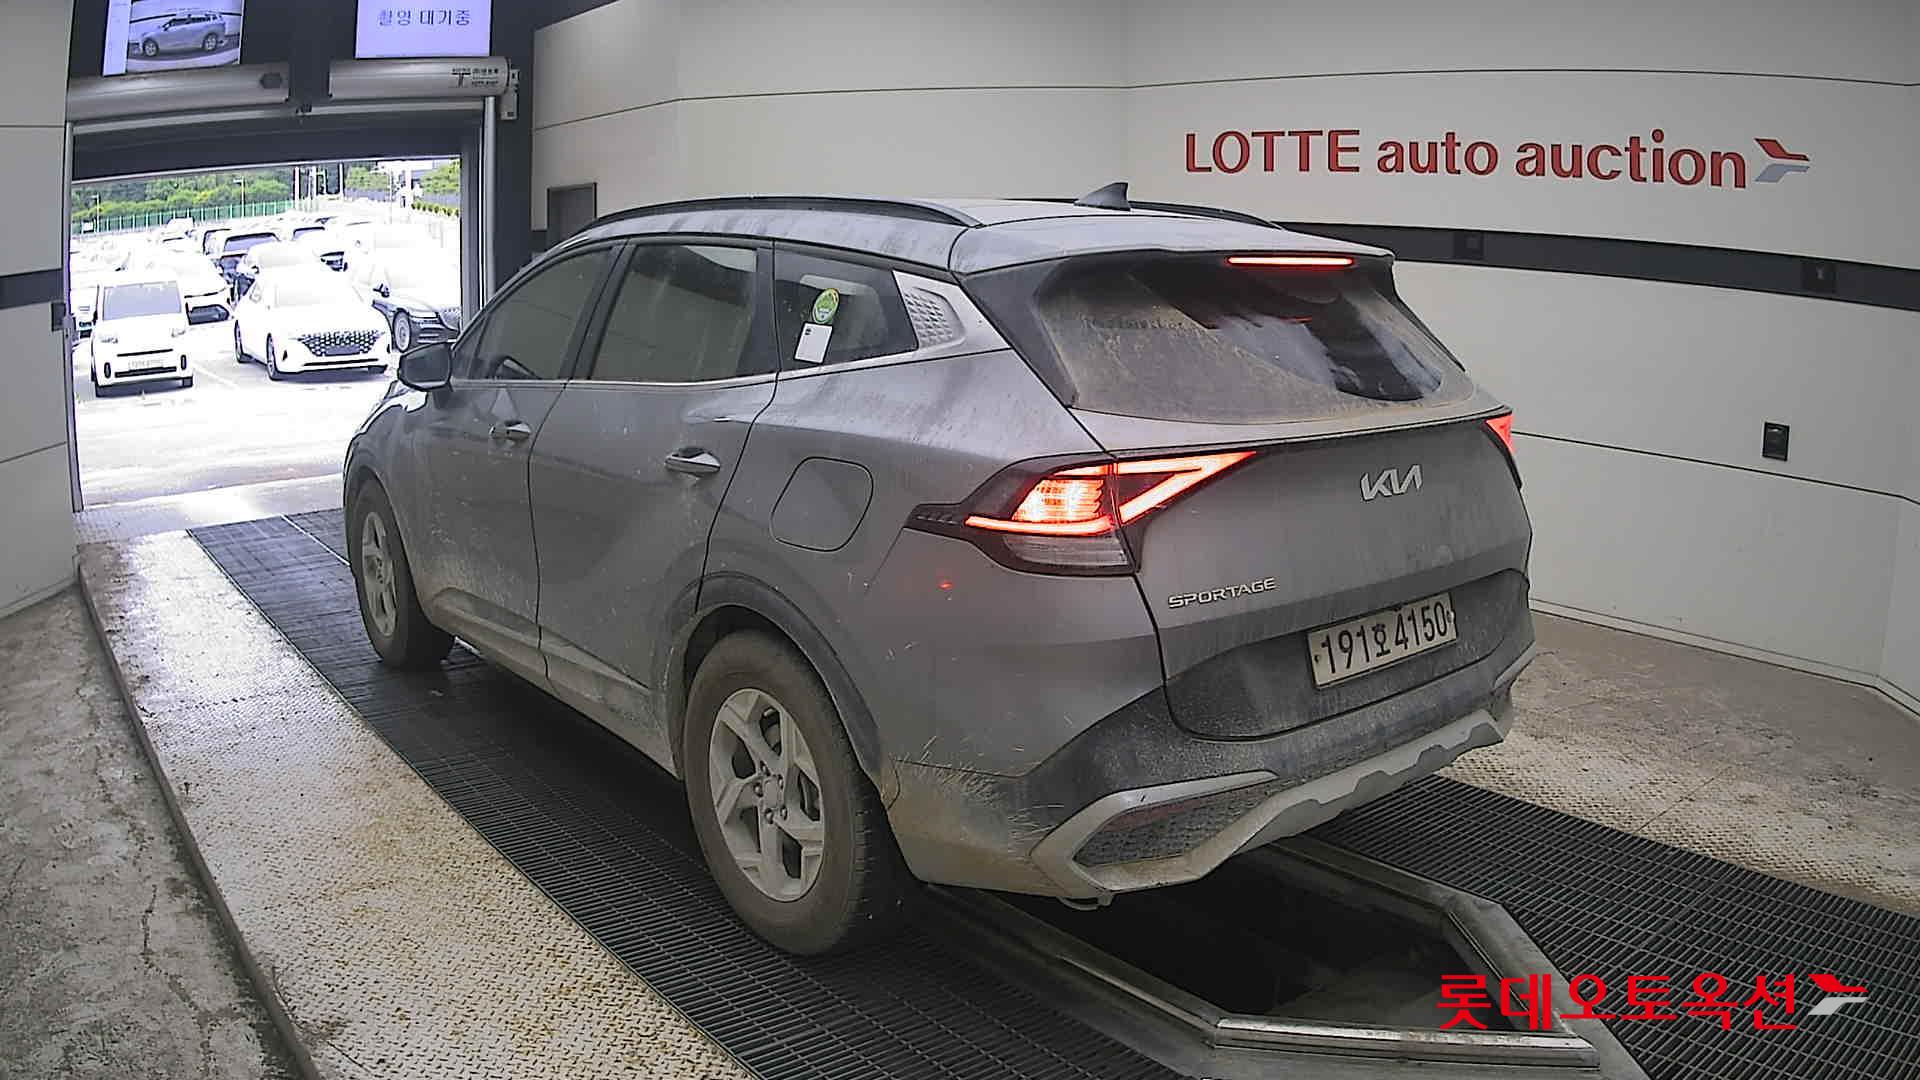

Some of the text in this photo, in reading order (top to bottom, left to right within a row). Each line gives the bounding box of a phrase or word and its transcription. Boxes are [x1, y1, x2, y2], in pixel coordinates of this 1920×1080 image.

[420, 9, 470, 26] 대기중
[1186, 129, 1746, 188] LOTTE auto auction
[1361, 464, 1423, 501] KIA
[1167, 576, 1277, 609] SPORTAGE
